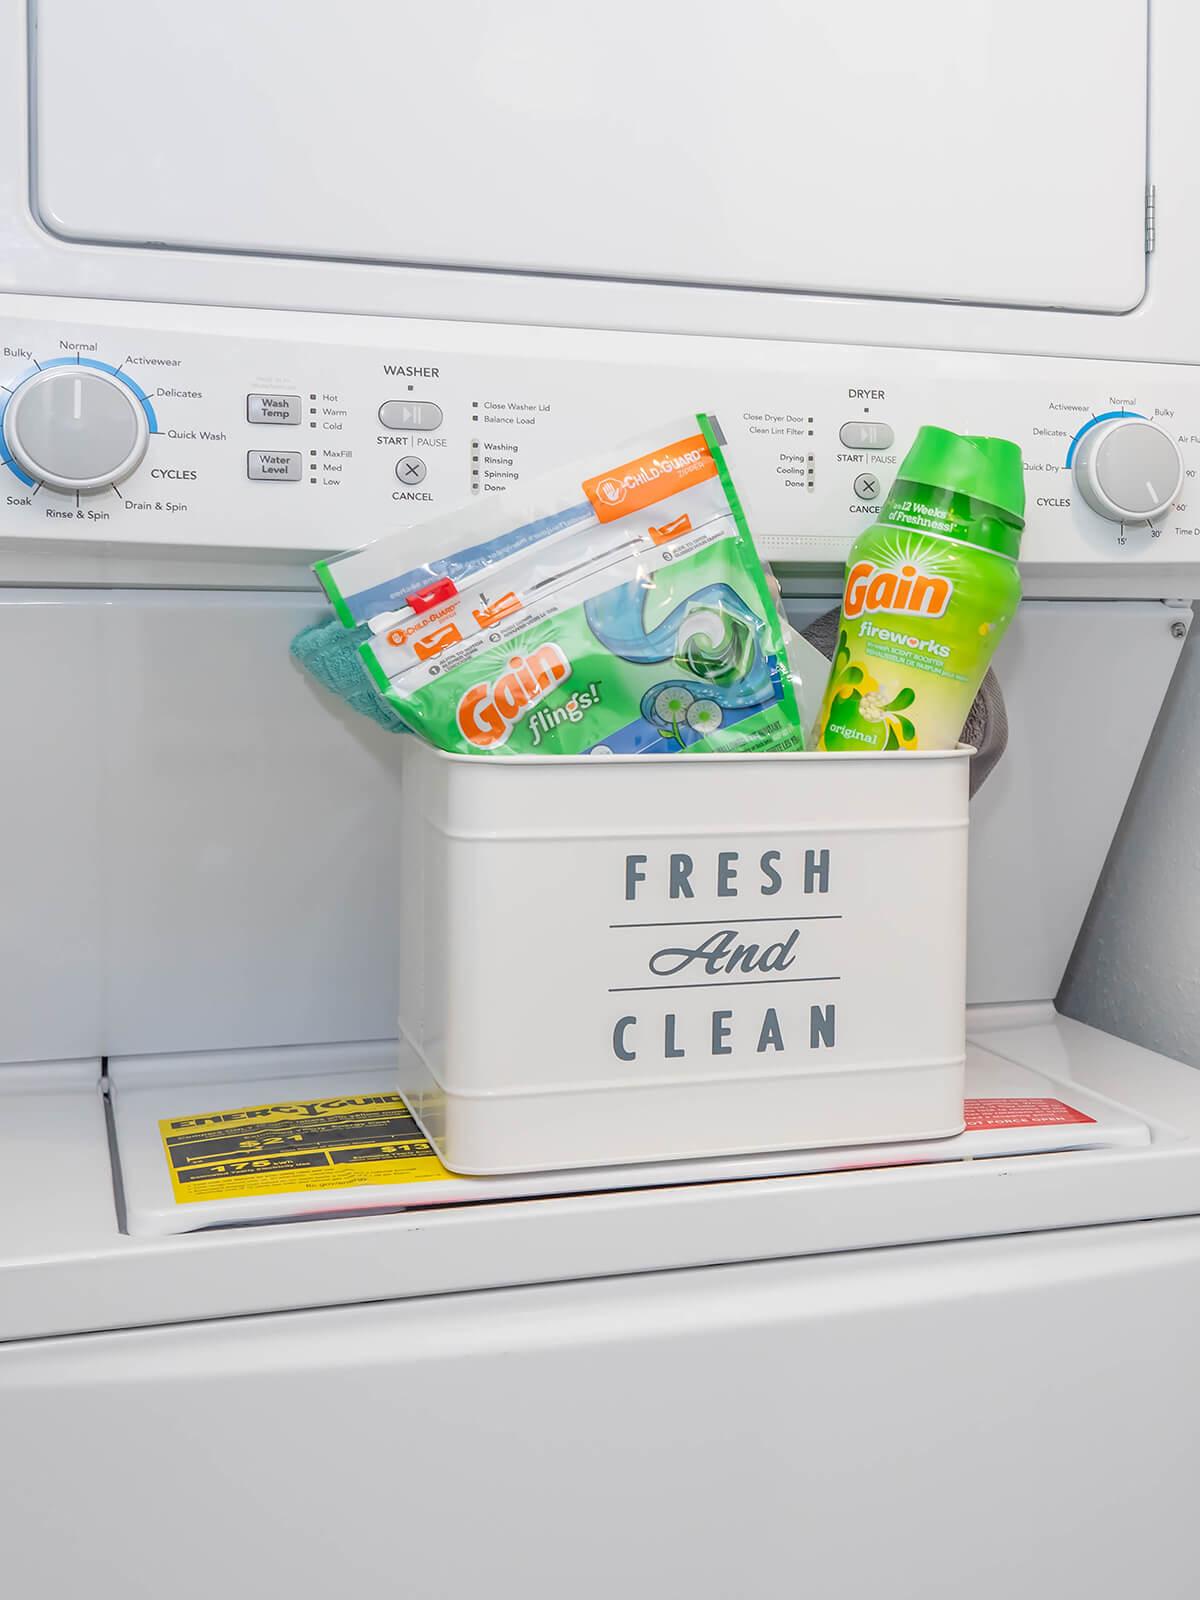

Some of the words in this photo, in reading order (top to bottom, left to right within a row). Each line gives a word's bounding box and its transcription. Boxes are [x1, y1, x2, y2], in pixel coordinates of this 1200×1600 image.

[60, 341, 98, 352] Normal
[4, 348, 33, 360] Bulky
[126, 356, 182, 367] Activewear
[384, 365, 440, 378] WASHER
[157, 388, 203, 399] Delicates
[323, 394, 338, 402] Hot
[848, 389, 885, 400] DRYER
[262, 399, 289, 408] Wash
[1109, 397, 1137, 406] Normal
[484, 402, 506, 410] Close
[508, 403, 536, 412] Washer
[538, 403, 551, 412] Lid
[1049, 402, 1090, 412] Activewear
[262, 408, 290, 420] Temp
[323, 408, 347, 417] Warm
[1154, 408, 1175, 418] Bulky
[484, 415, 514, 424] Balance
[516, 416, 536, 425] Load
[743, 413, 763, 421] Close
[764, 414, 784, 424] Dryer
[786, 415, 804, 423] Door
[323, 422, 342, 430] Cold
[749, 426, 769, 435] Clean
[771, 427, 785, 435] Lint
[786, 428, 805, 436] Filter
[168, 430, 197, 440] Quick
[200, 431, 227, 441] Wash
[1032, 428, 1067, 438] Delicates
[376, 436, 408, 446] START
[417, 437, 447, 447] PAUSE
[1178, 435, 1190, 444] Air
[484, 443, 518, 453] Washing
[260, 455, 291, 465] Water
[484, 457, 513, 466] Rinsing
[780, 454, 805, 463] Drying
[837, 454, 864, 463] START
[871, 455, 897, 464] PAUSE
[262, 465, 289, 474] Level
[323, 464, 342, 472] Med
[776, 467, 805, 476] Cooling
[1023, 462, 1044, 472] Quick
[1045, 464, 1060, 473] Dry
[151, 469, 197, 480] CYCLES
[484, 470, 519, 480] Spinning
[323, 478, 341, 486] Low
[785, 480, 805, 488] Done
[484, 484, 506, 492] Done
[6, 497, 32, 506] Soak
[392, 491, 434, 502] CANCEL
[125, 500, 152, 511] Drain
[155, 502, 163, 511] &
[166, 502, 188, 514] Spin
[1036, 498, 1071, 508] CYCLES
[849, 505, 881, 514] CANCE
[902, 501, 912, 512] 12
[912, 502, 947, 519] Weeks
[46, 509, 73, 519] Rinse
[77, 510, 85, 519] &
[87, 510, 110, 522] Spin
[888, 511, 899, 521] of
[1175, 527, 1193, 536] Time
[844, 561, 953, 620] Gain
[858, 622, 951, 658] fireworks
[458, 644, 572, 748] Gain
[829, 723, 878, 746] original
[625, 849, 830, 901] FRESH
[649, 928, 801, 976] And
[612, 1004, 836, 1062] CLEAN
[210, 1159, 271, 1173] 175
